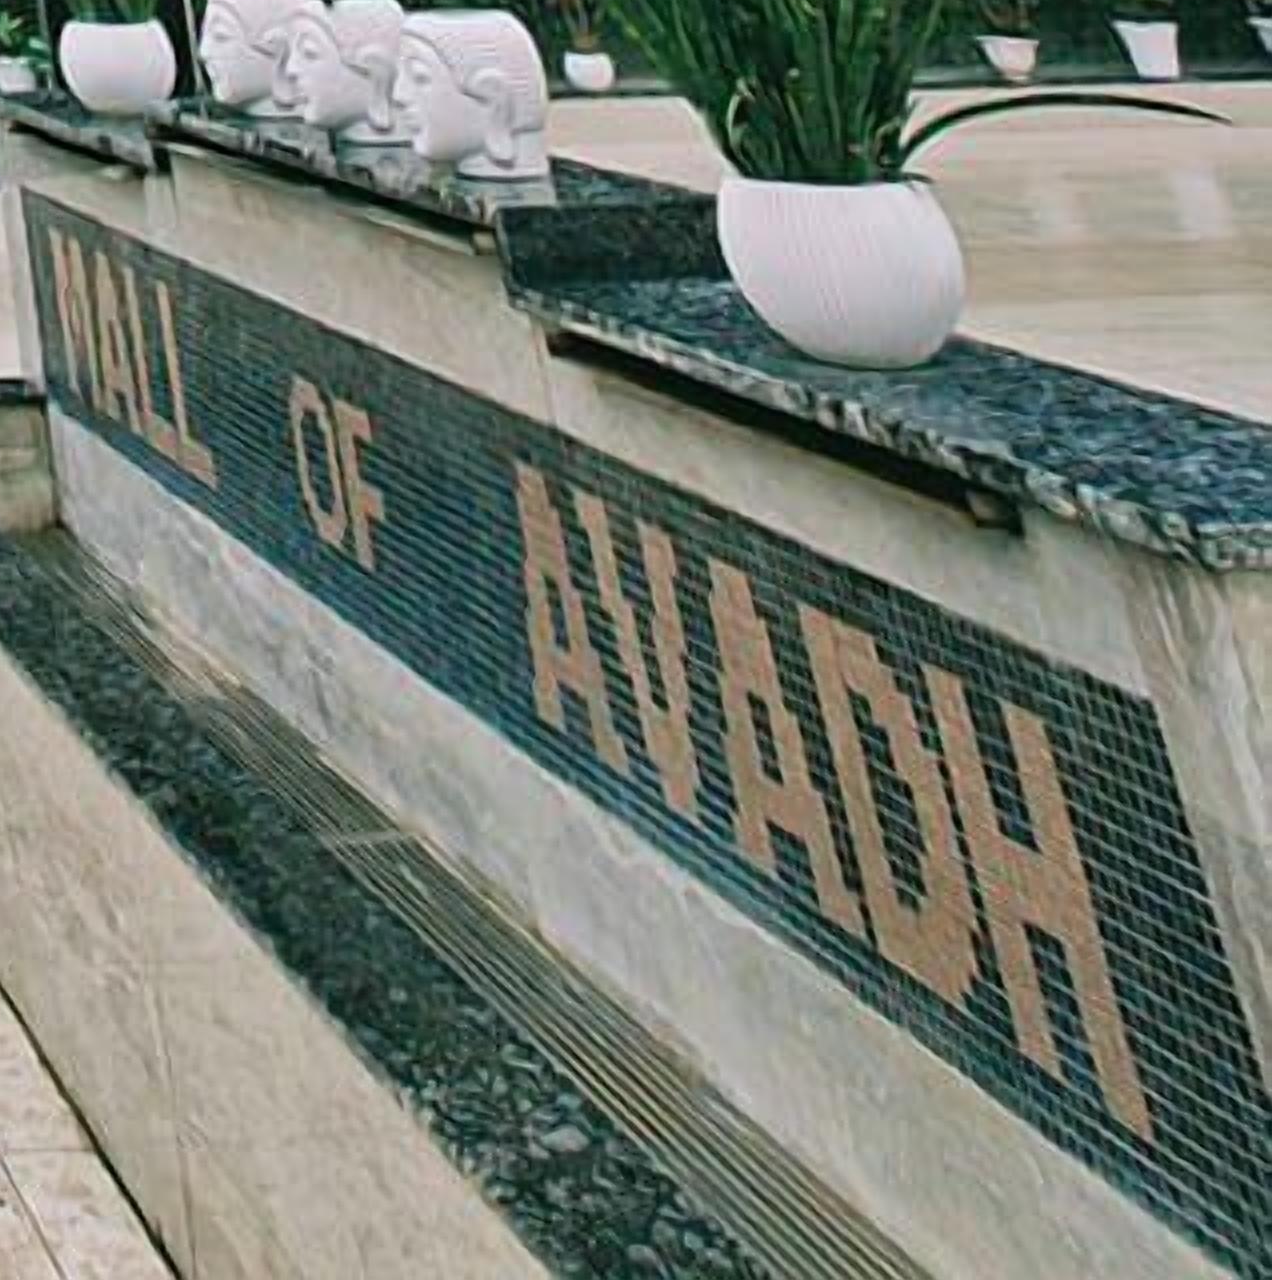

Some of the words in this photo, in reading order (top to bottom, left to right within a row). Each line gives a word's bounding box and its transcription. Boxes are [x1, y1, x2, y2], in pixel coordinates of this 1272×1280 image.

[48, 226, 218, 493] MALL
[290, 373, 386, 573] OF
[513, 458, 1155, 1144] AVADH
